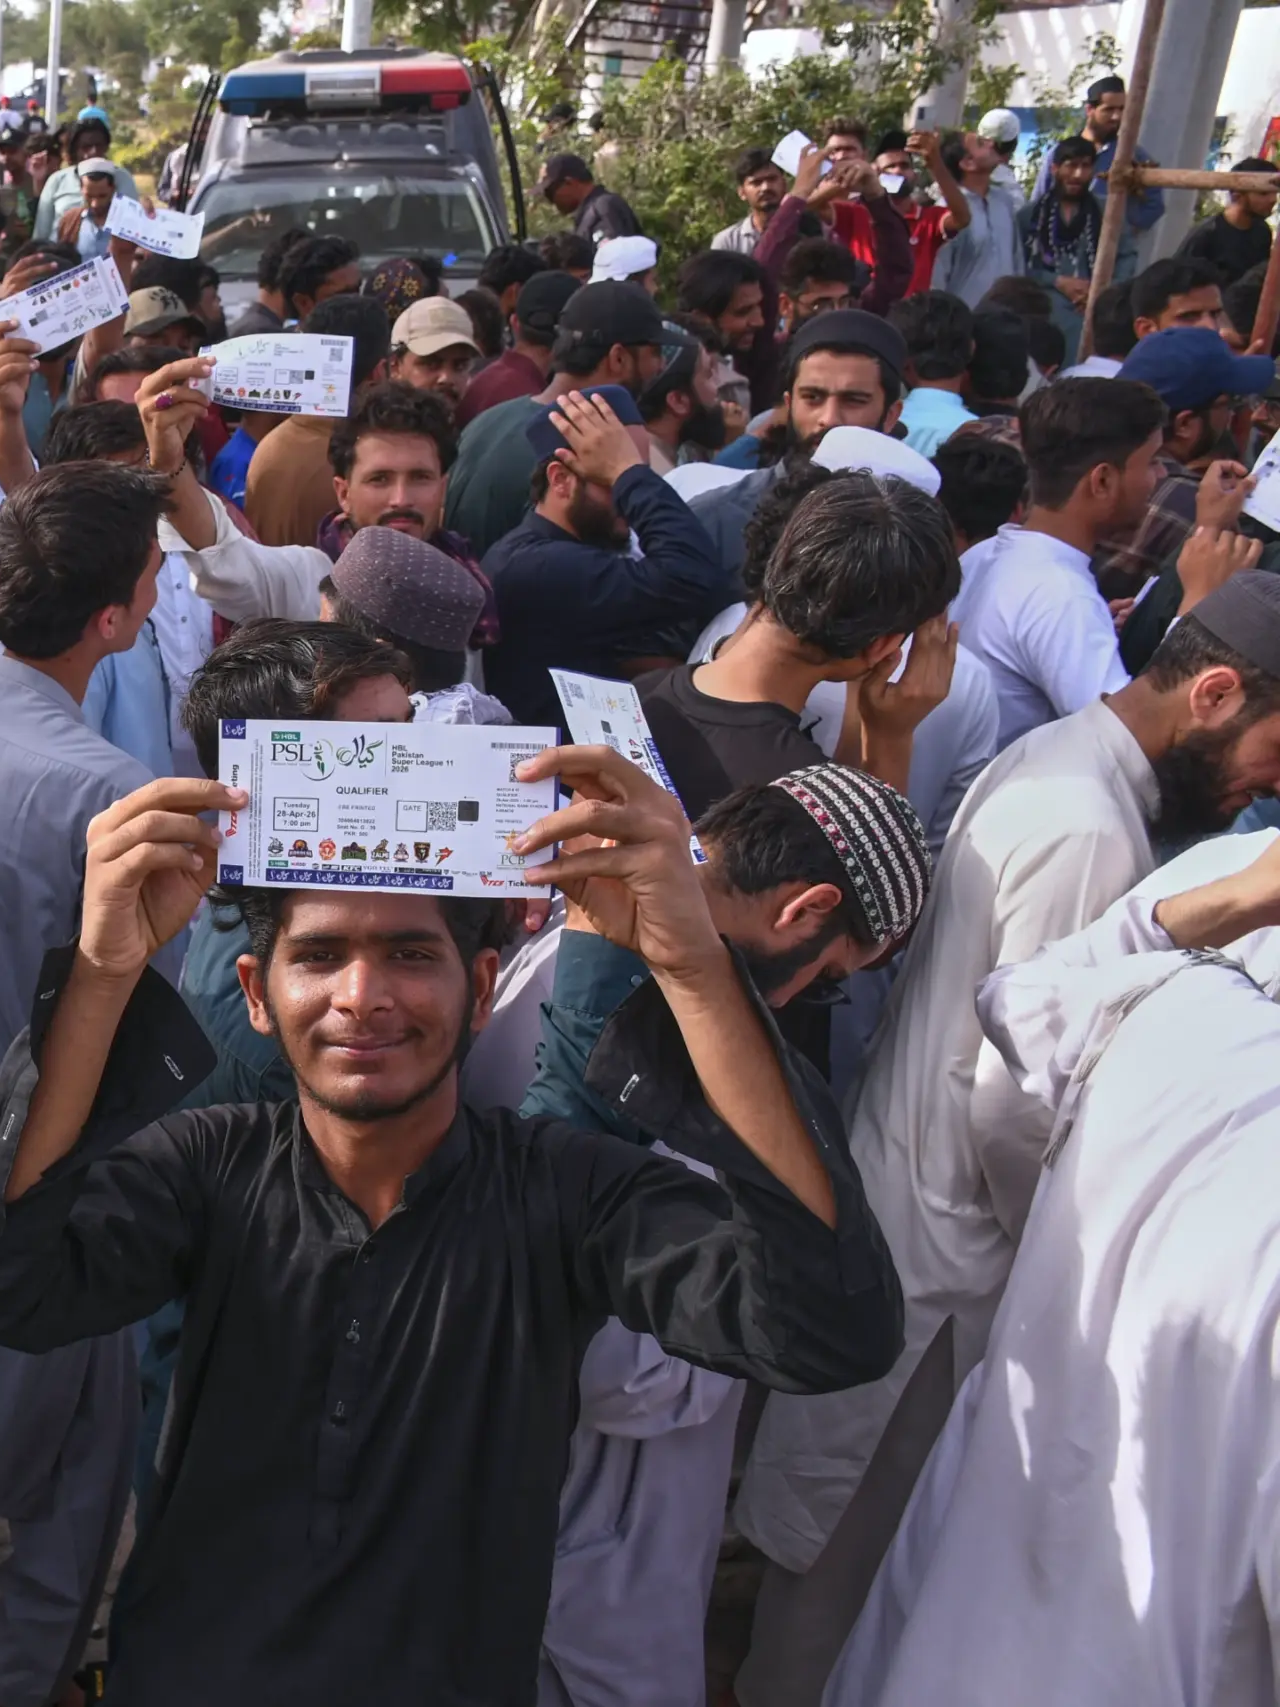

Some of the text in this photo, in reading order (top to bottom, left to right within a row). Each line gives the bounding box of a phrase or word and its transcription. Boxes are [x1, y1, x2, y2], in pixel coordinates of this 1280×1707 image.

[270, 743, 312, 762] PSL
[392, 758, 414, 766] Super
[416, 759, 443, 767] League
[336, 786, 388, 795] QUALIFIER
[283, 802, 310, 810] Tuesday
[277, 810, 316, 819] 28-Apr-26
[501, 855, 526, 865] PCB
